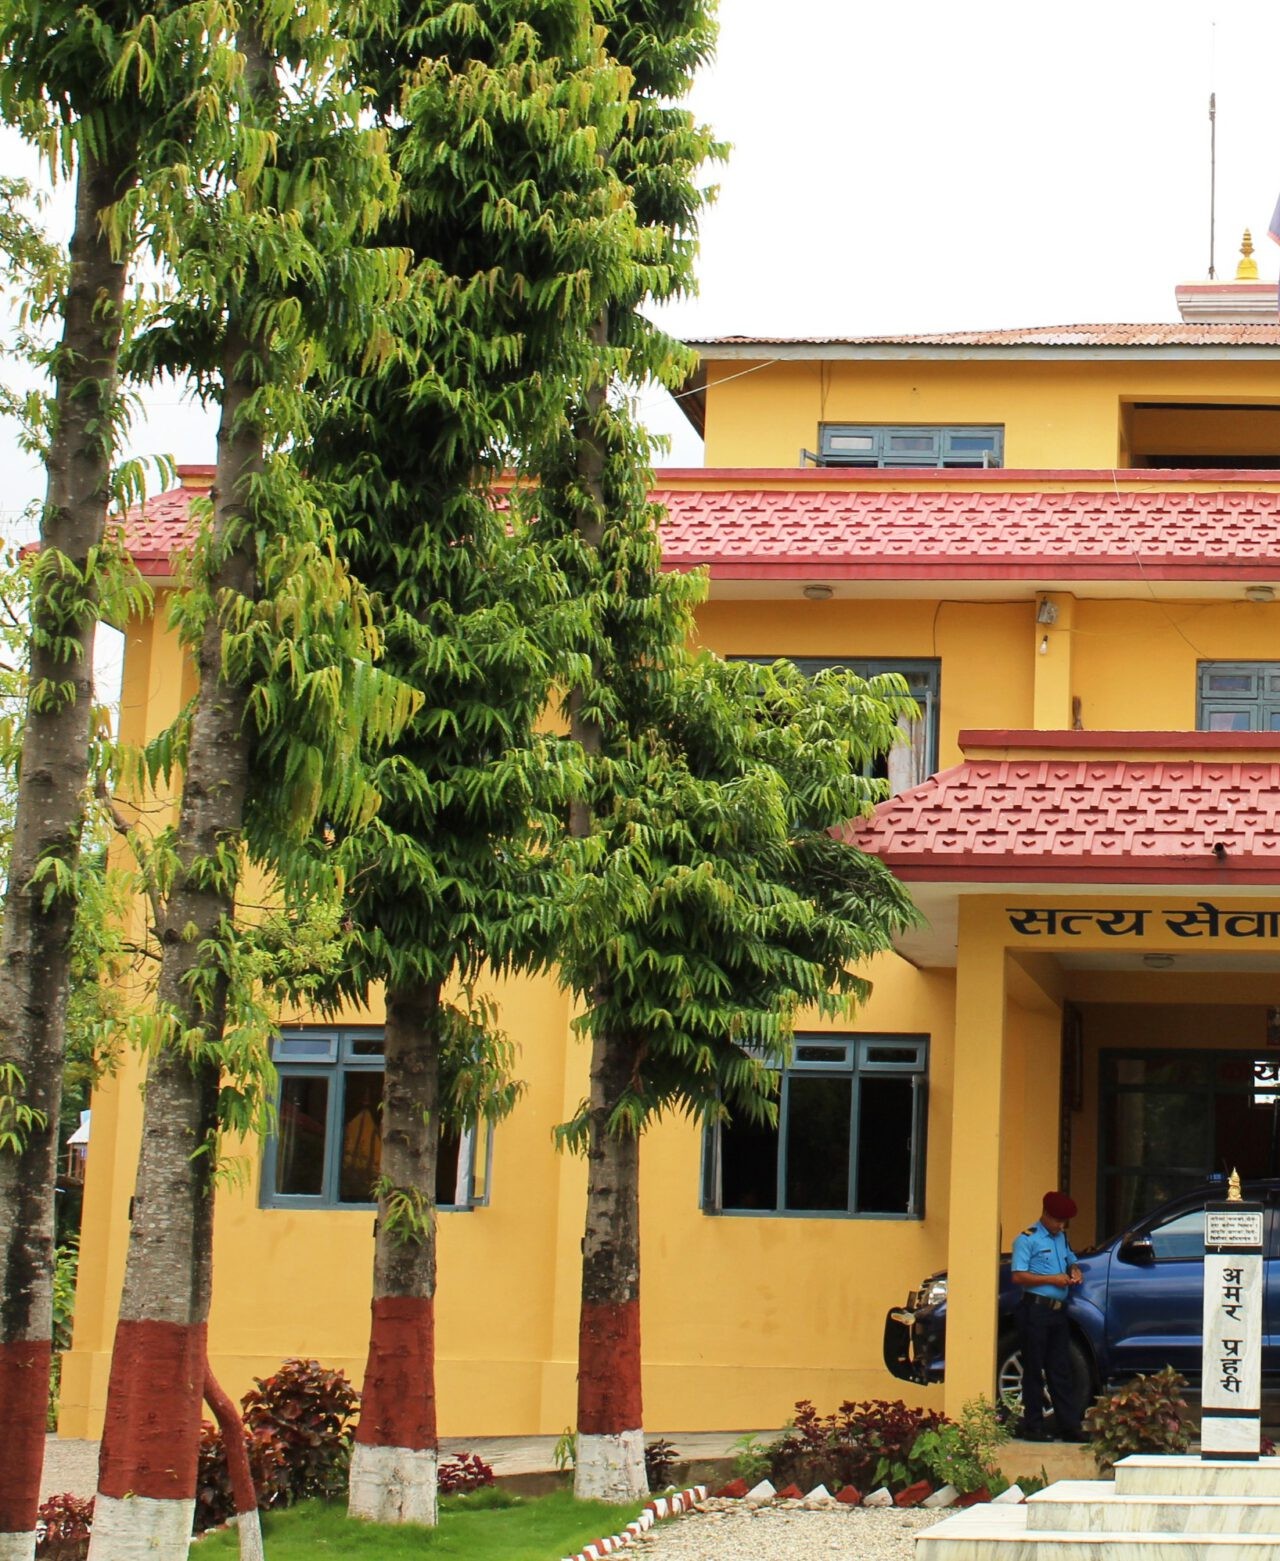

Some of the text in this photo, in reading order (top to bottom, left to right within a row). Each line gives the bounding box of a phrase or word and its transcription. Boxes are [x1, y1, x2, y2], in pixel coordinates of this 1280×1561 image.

[1005, 907, 1152, 937] सत्य
[1221, 1268, 1244, 1321] अमर
[1220, 1339, 1244, 1393] प्रहरी
